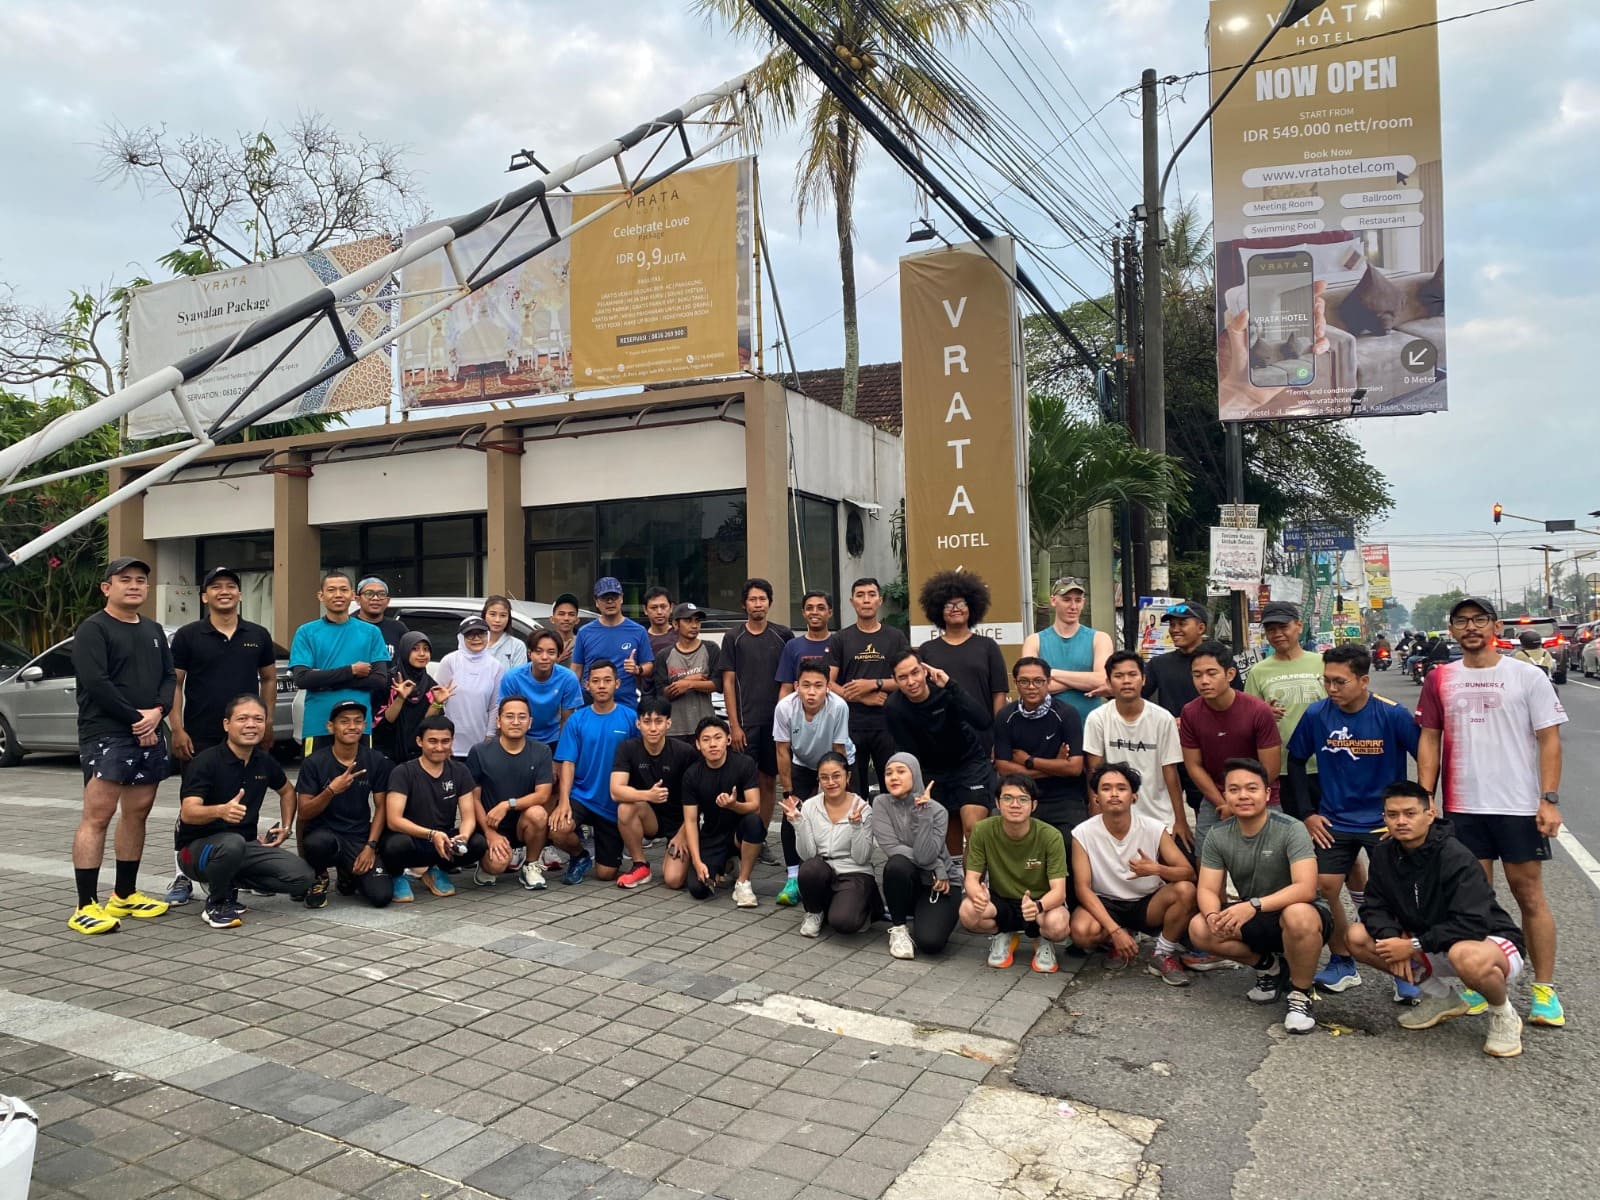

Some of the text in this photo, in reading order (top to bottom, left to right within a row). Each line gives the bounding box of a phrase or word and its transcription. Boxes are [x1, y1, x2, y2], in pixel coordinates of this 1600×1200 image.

[1296, 31, 1354, 46] HOTEL
[1256, 56, 1397, 101] NOW OPEN
[1299, 108, 1354, 120] START FROM
[1243, 116, 1413, 142] IDR 549.000 nett/room
[1303, 147, 1353, 160] Book Now
[1262, 160, 1395, 182] www.vratahotel.com
[625, 190, 679, 208] VRATA
[1362, 192, 1402, 203] Ballroom
[1253, 199, 1313, 212] Meeting Room
[613, 216, 690, 238] Celebrate Love
[1359, 215, 1406, 225] Restaurant
[1251, 222, 1317, 235] Swimming Pool
[616, 247, 687, 270] IDR 9,9 JUTA
[1258, 262, 1298, 270] VRATA
[204, 275, 247, 292] VRATA
[177, 298, 270, 326] Syawalan Package
[1254, 313, 1308, 323] VRATA HOTEL
[1411, 375, 1437, 384] Meter
[942, 297, 975, 516] VRATA
[937, 533, 989, 549] HOTEL
[931, 628, 1003, 640] ENNCE
